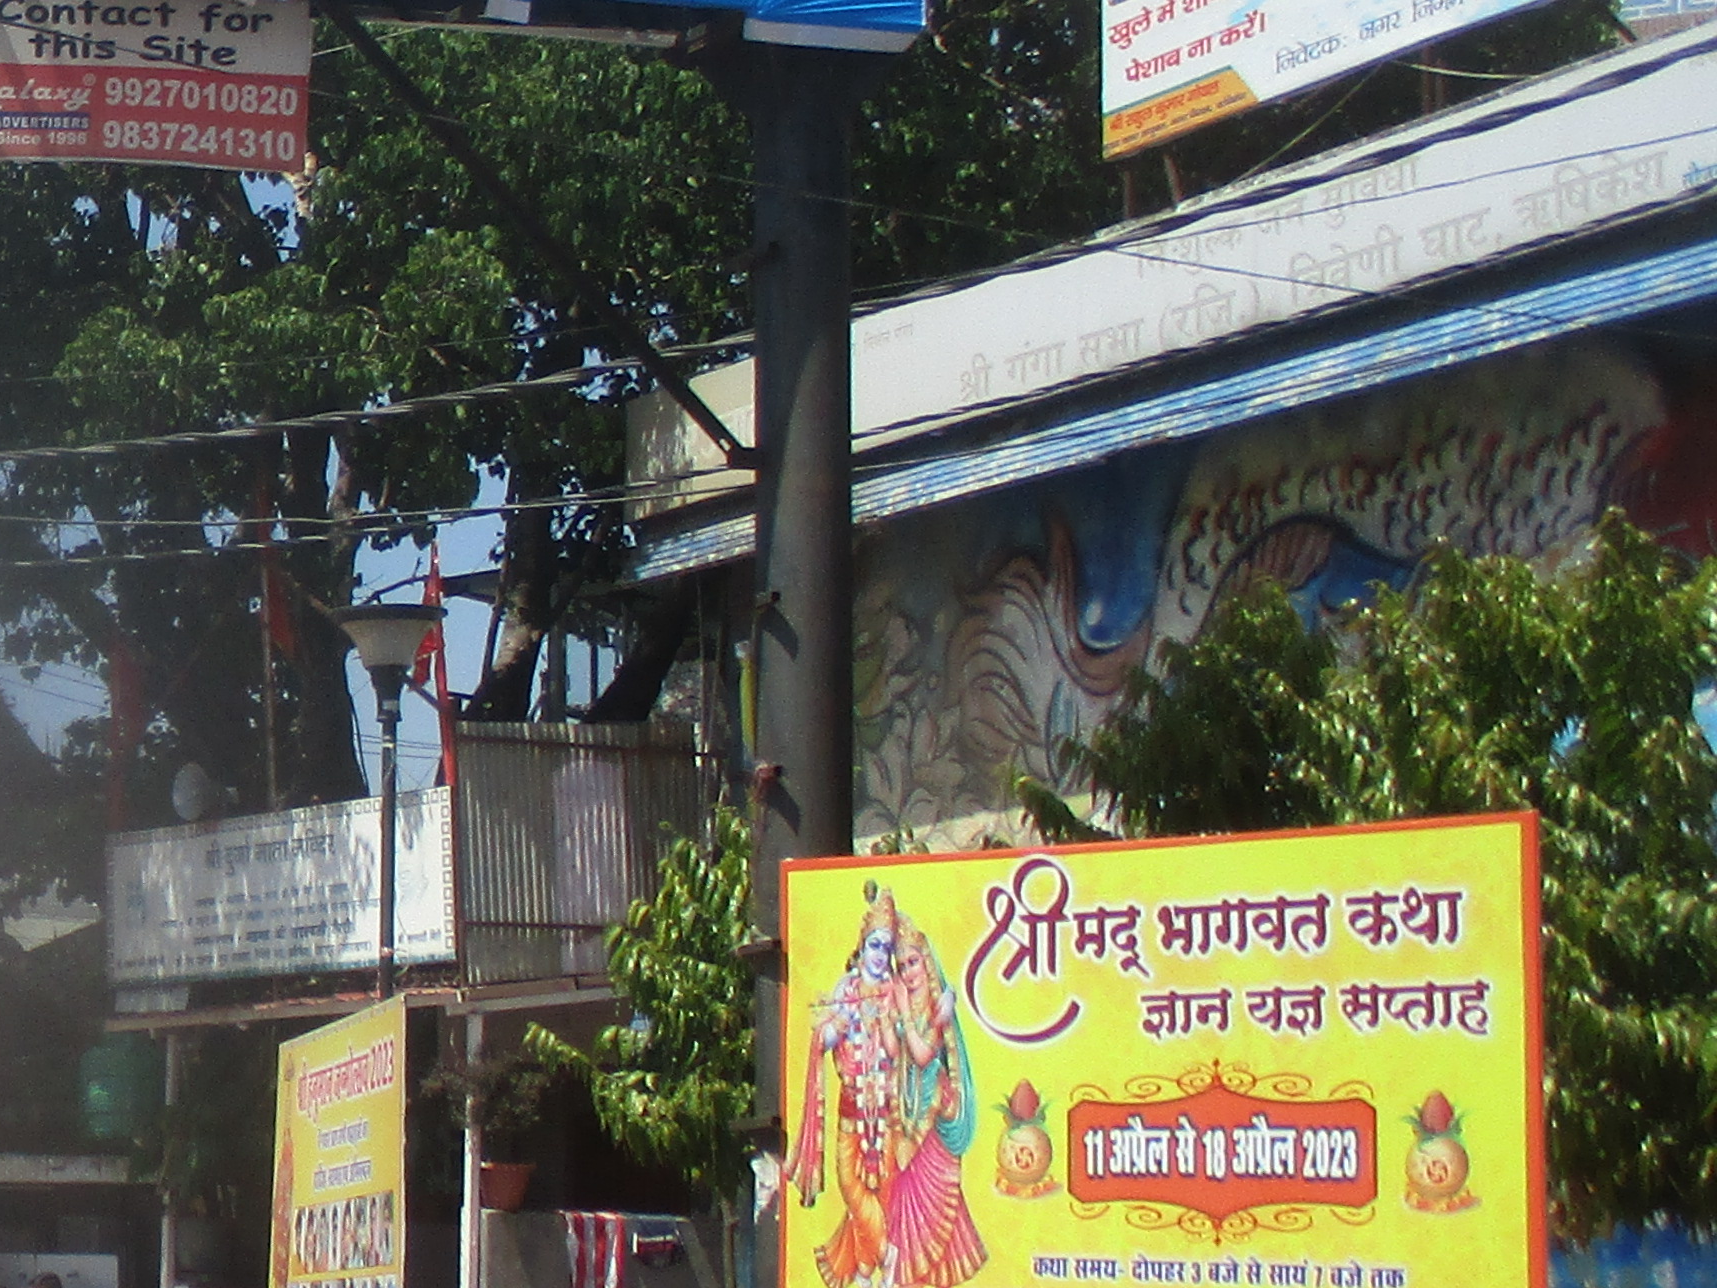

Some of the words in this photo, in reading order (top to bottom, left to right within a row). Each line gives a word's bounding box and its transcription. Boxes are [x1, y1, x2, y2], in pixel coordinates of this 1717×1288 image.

[201, 2, 273, 34] for
[1108, 6, 1153, 50] खुले
[1358, 9, 1403, 42] नगर
[28, 32, 116, 60] this
[142, 34, 237, 66] Site
[1187, 35, 1213, 58] ना
[105, 77, 298, 116] 9927010820
[102, 120, 296, 162] 9837241310
[959, 352, 993, 402] श्री
[1004, 342, 1064, 383] गंगा
[1077, 318, 1145, 366] सभा
[1289, 223, 1403, 305] त्रिवेणी
[1512, 150, 1668, 229] ऋषिकेश
[1158, 893, 1331, 956] भागवत
[1347, 887, 1463, 946] कथा
[1141, 988, 1233, 1040] ज्ञान
[1247, 984, 1326, 1031] यज्ञ
[1340, 979, 1490, 1037] सप्ताह
[1084, 1131, 1105, 1175] 11
[1108, 1115, 1171, 1178] अप्रैल
[1176, 1116, 1197, 1178] से
[1203, 1132, 1226, 1180] 18
[1232, 1114, 1298, 1182] अप्रैल
[1303, 1130, 1359, 1181] 2023
[1032, 1255, 1068, 1280] कथा
[1132, 1256, 1185, 1283] दोपहर
[1191, 1261, 1201, 1283] 3
[1208, 1257, 1239, 1286] बजे
[1246, 1258, 1262, 1286] से
[1269, 1259, 1309, 1288] सायं
